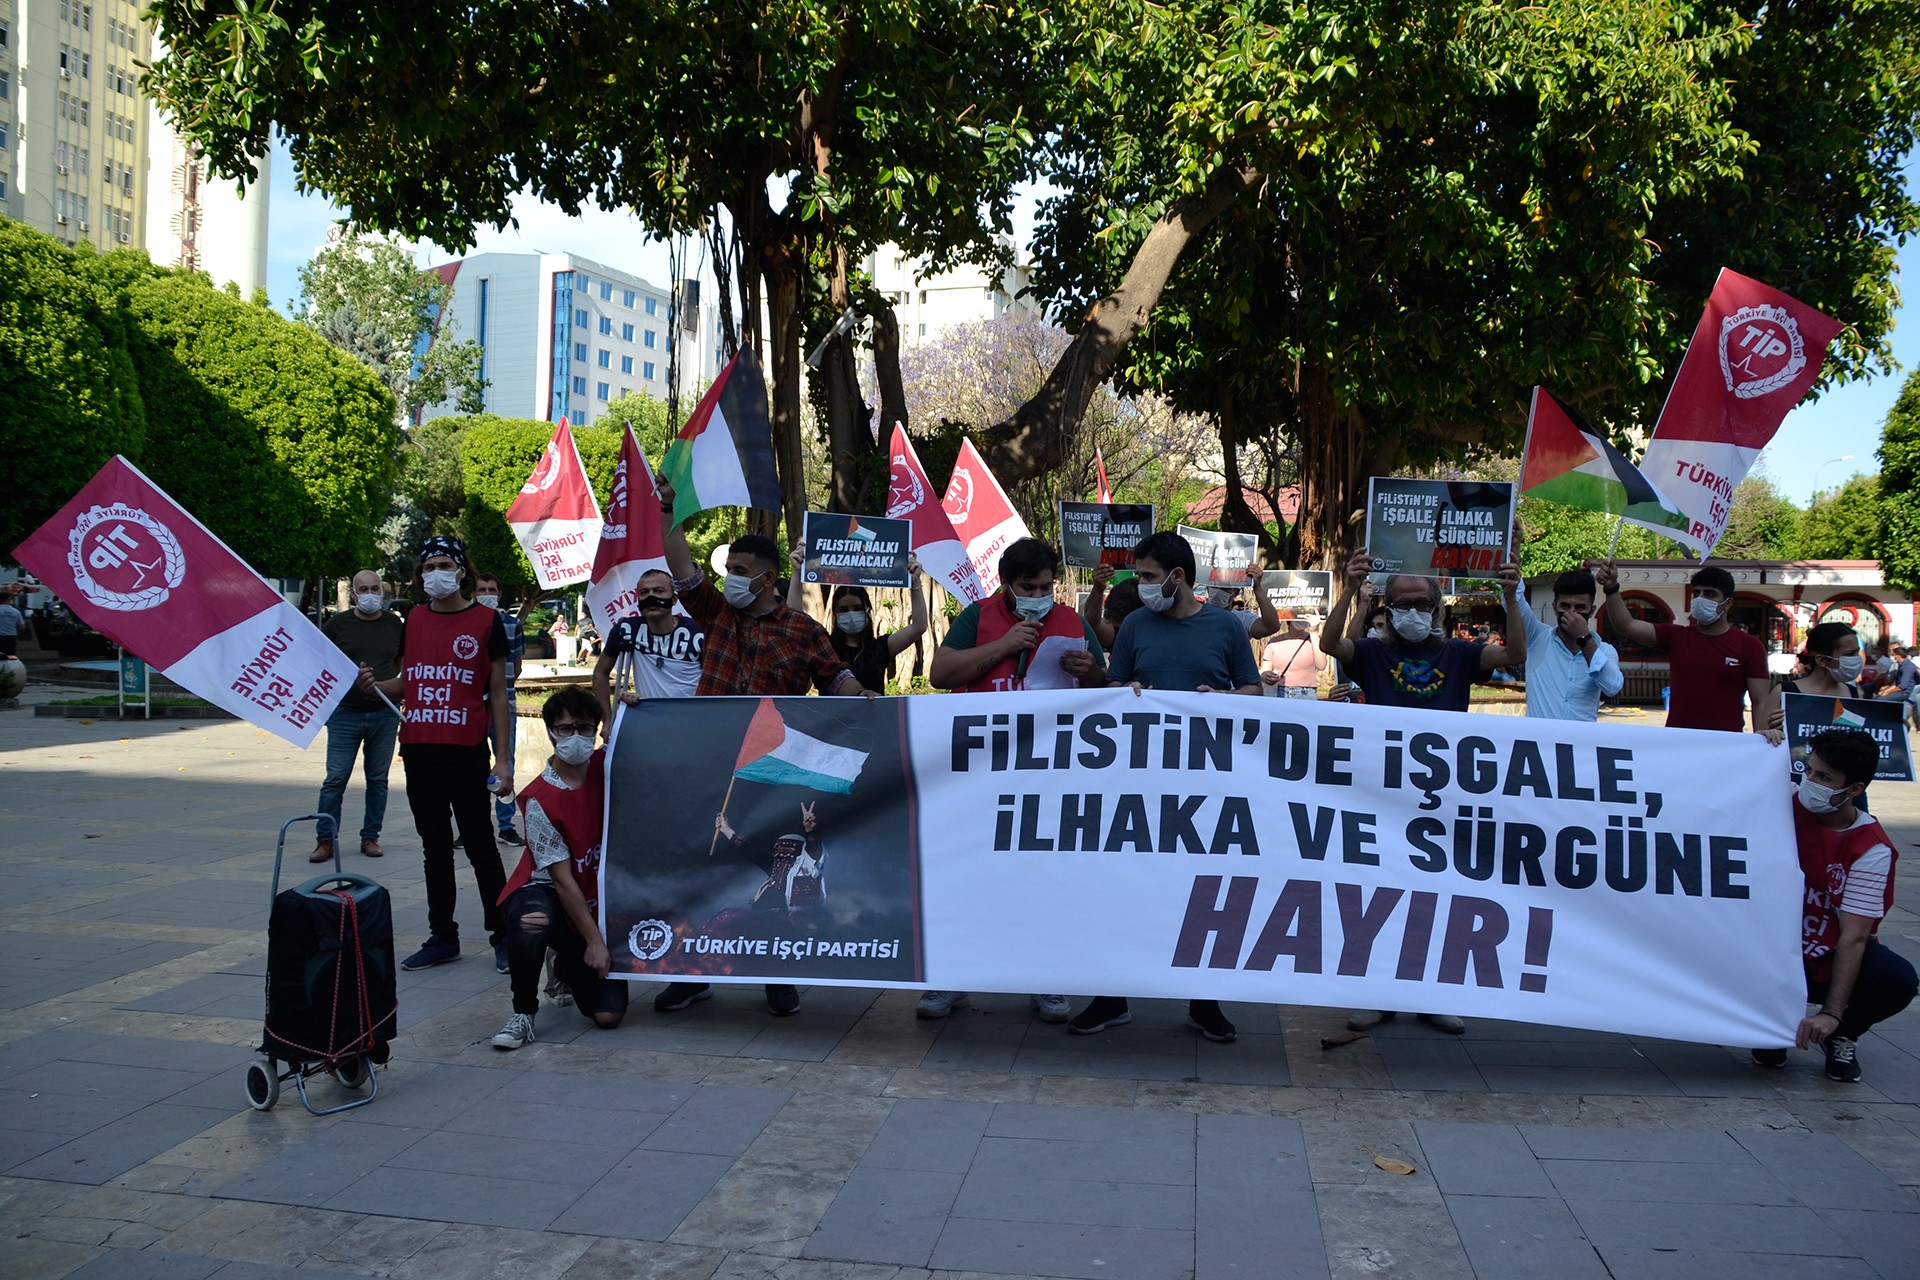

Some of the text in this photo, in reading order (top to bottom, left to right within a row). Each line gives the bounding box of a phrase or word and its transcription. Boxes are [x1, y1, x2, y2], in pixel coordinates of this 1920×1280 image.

[1727, 310, 1802, 358] TÜRKİYE İŞÇİ PARTİSİ
[1739, 325, 1787, 358] TİP
[1676, 460, 1732, 503] TÜRKİYE
[1377, 492, 1439, 507] FİLİSTİN'DE
[1065, 512, 1102, 521] FİLİSTİN'DE
[1383, 507, 1494, 526] İŞGALE, İLHAKA
[1709, 496, 1729, 528] İŞÇİ
[1069, 522, 1141, 535] İŞGALE, İLHAKA
[1416, 528, 1503, 546] VE SÜRGÜNE
[816, 538, 899, 554] FİLİSTİN HALKI
[1089, 535, 1142, 547] VE SÜRGÜN
[820, 554, 895, 568] KAZANACAK!
[1100, 549, 1137, 566] HAYI
[1200, 558, 1211, 567] VE
[1430, 546, 1503, 571] HAYIR!
[406, 662, 474, 685] TÜRKİYE
[418, 683, 451, 705] İŞÇİ
[951, 712, 1663, 819] FİLİSTİN'DE İŞGALE,
[994, 794, 1751, 901] İLHAKA VE SÜRGÜNE
[641, 928, 664, 941] TİP
[1171, 874, 1554, 994] HAYIR!
[1803, 915, 1829, 937] Çİ
[683, 935, 900, 960] TÜRKİYE İŞÇİ PARTİSİ
